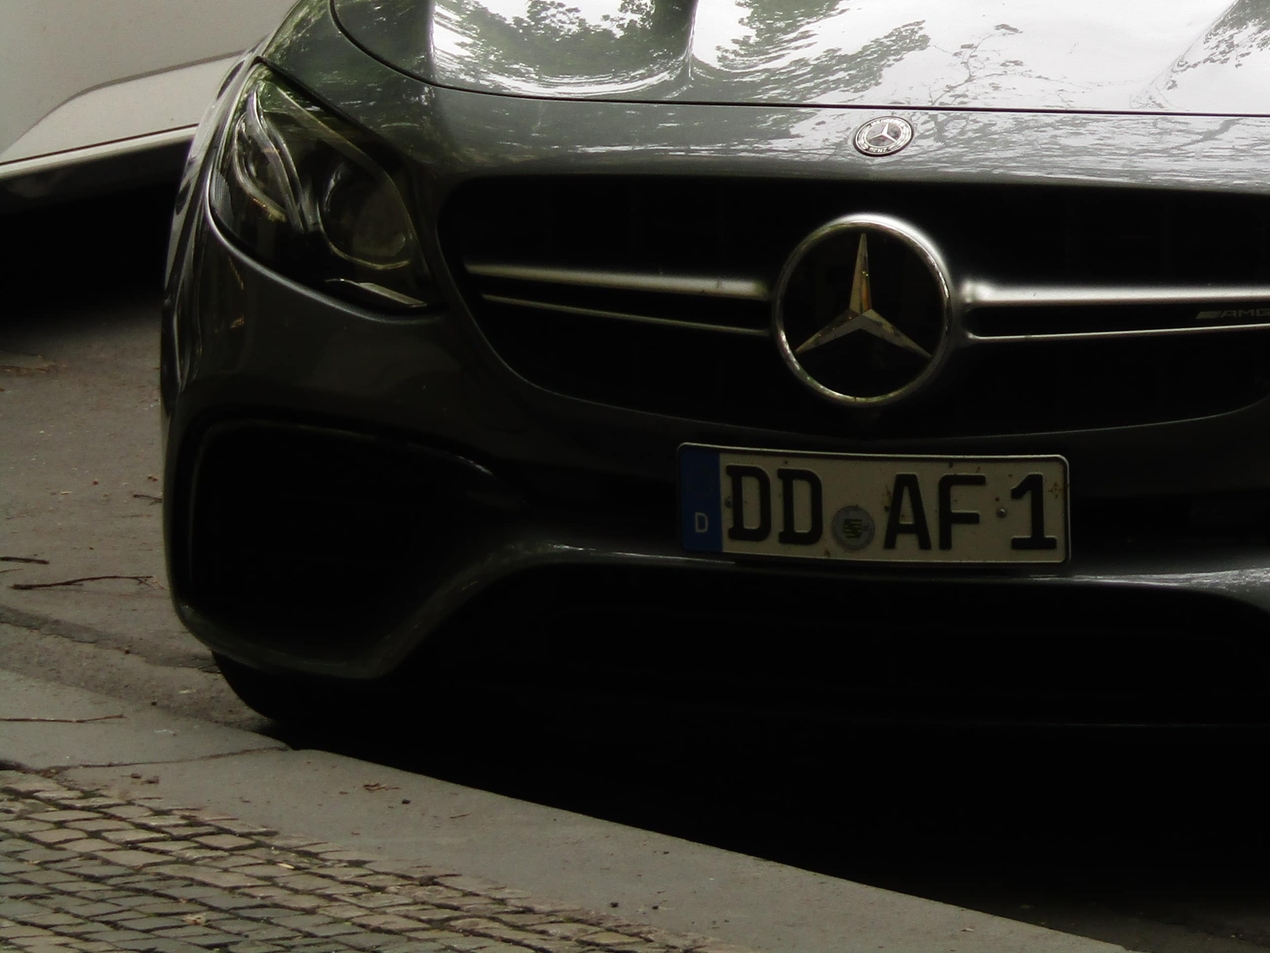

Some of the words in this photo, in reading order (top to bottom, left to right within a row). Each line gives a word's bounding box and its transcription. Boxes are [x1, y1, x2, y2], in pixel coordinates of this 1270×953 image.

[694, 512, 709, 534] D
[725, 464, 824, 546] DD
[882, 473, 987, 551] AF
[1010, 473, 1058, 551] 1
